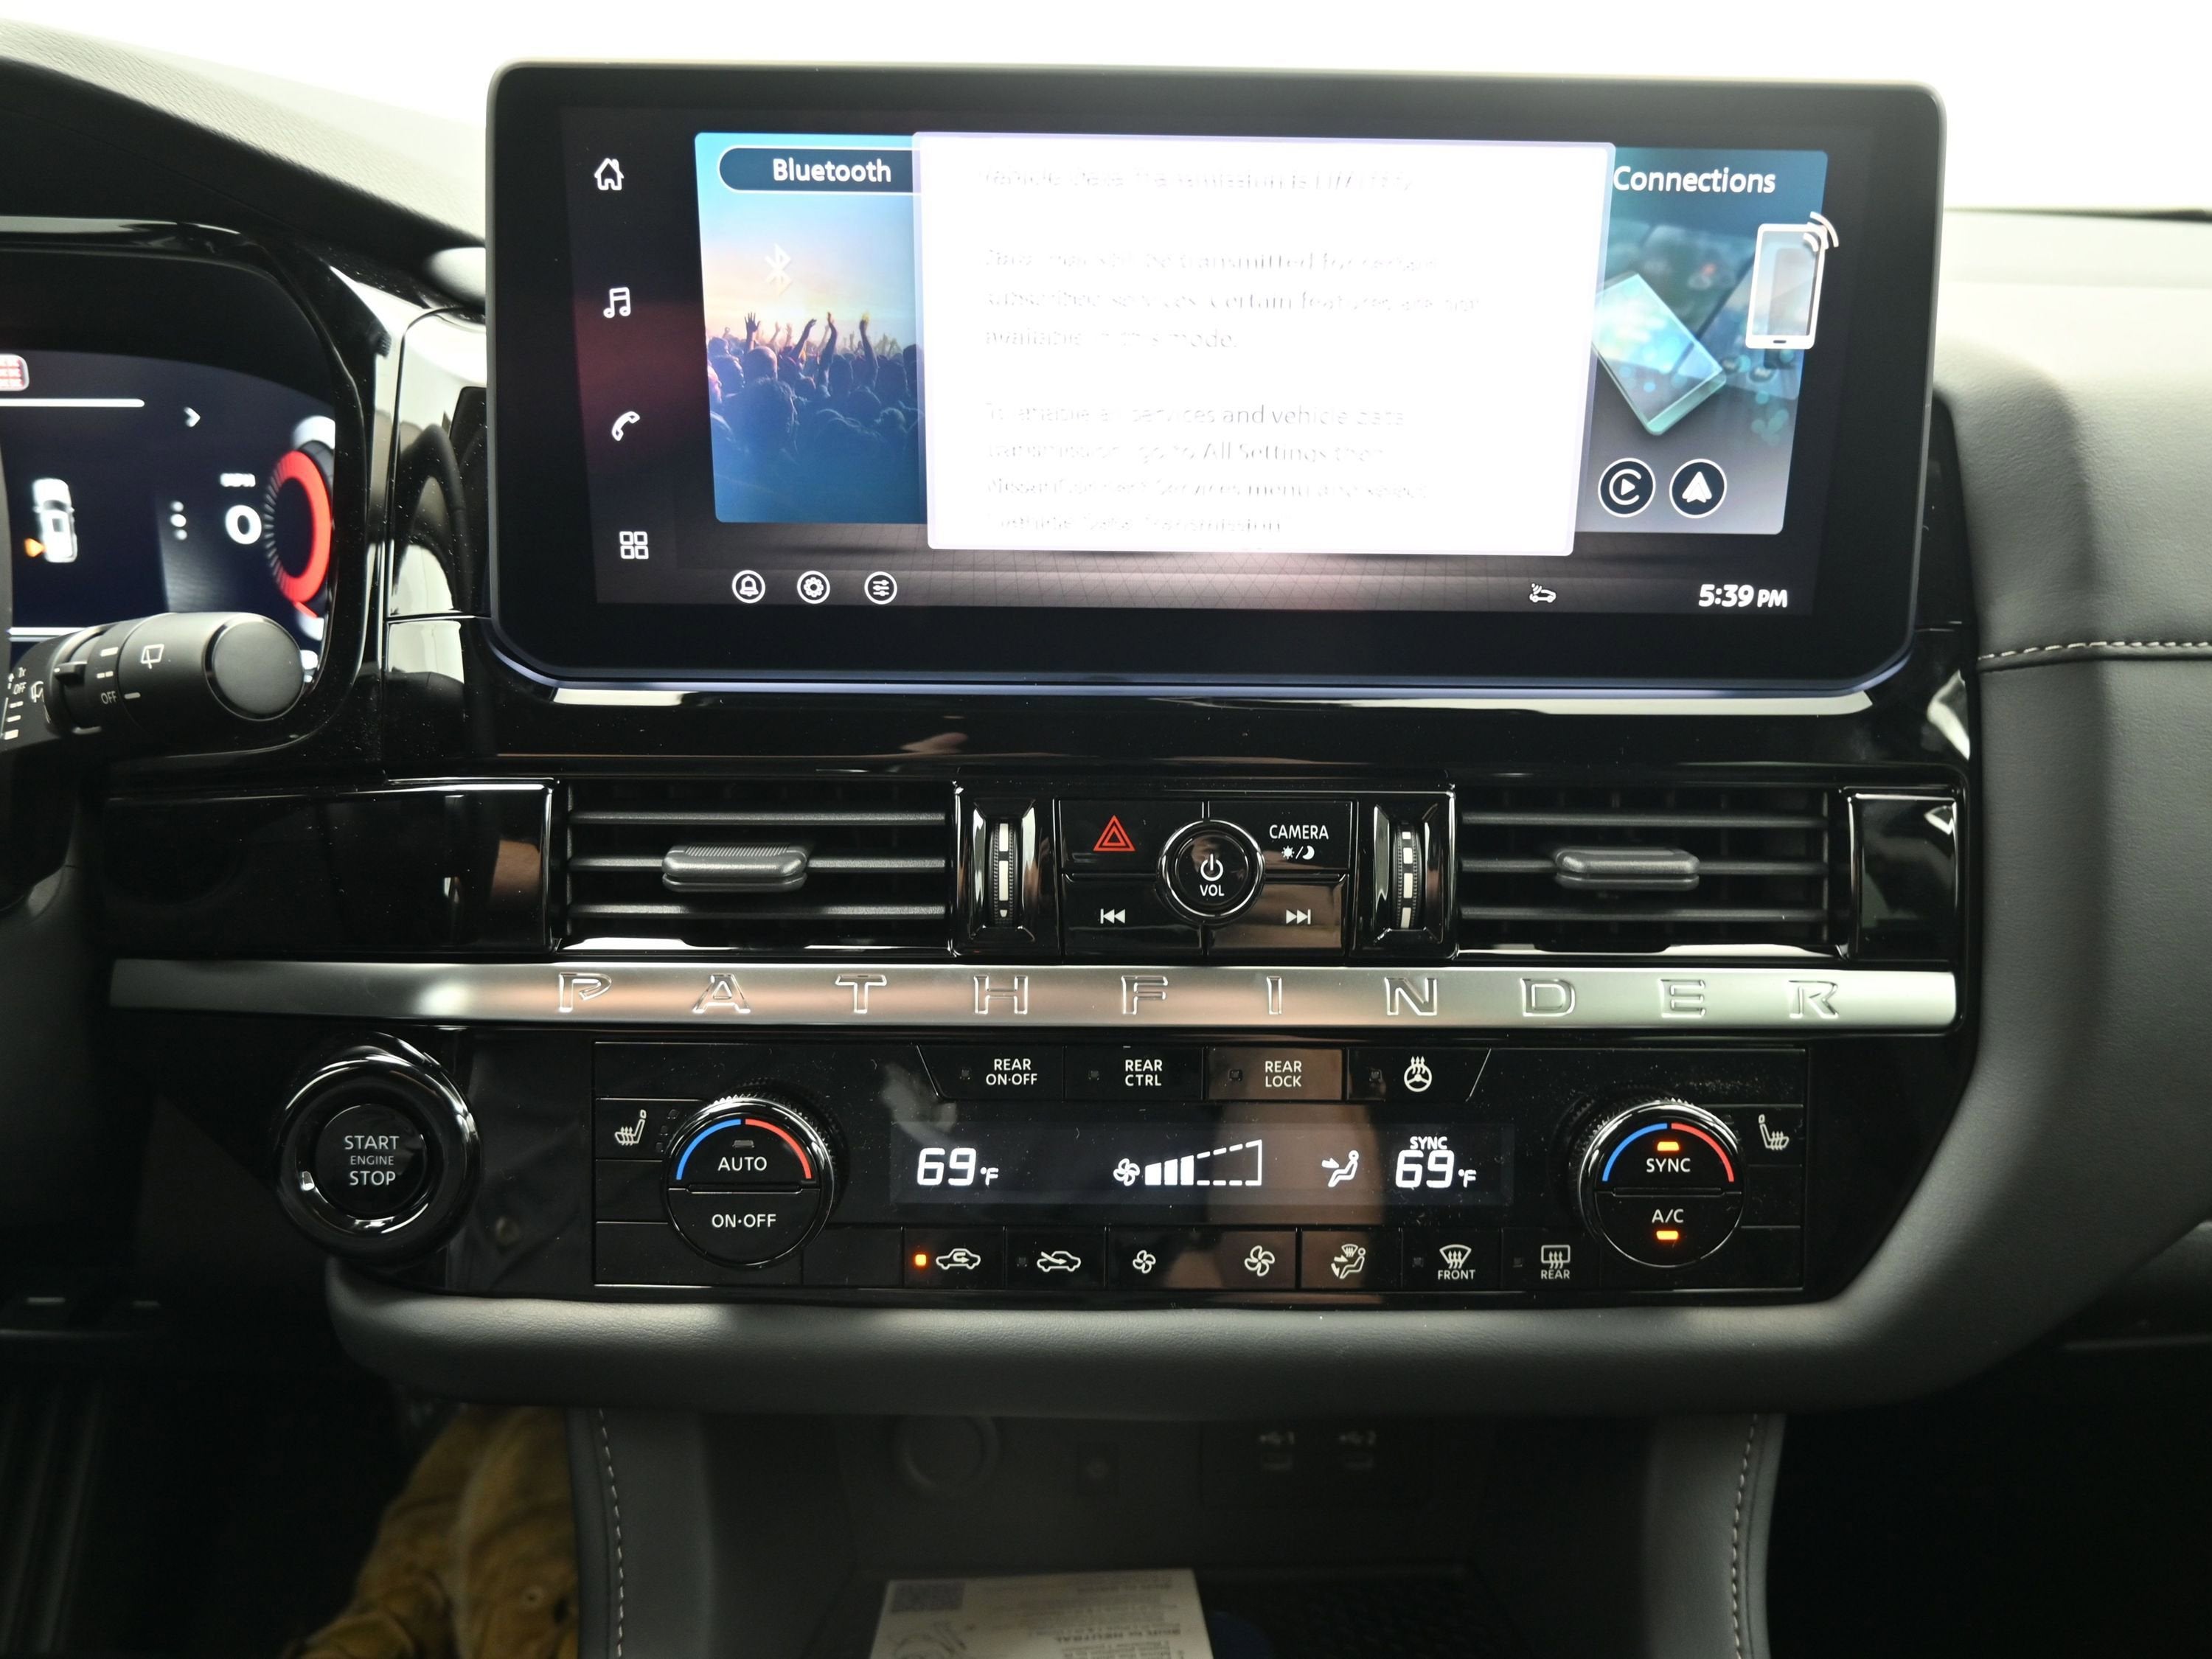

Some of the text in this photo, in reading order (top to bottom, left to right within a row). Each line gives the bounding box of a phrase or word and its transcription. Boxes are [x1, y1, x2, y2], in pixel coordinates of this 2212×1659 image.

[773, 157, 891, 183] Bluetooth
[1613, 166, 1776, 194] Connections
[1222, 403, 1265, 425] and
[1271, 402, 1349, 426] vehicle
[1203, 440, 1232, 461] All
[1698, 584, 1788, 608] 5:39 PM
[13, 681, 27, 695] OFF
[100, 691, 117, 705] OFF
[1269, 824, 1329, 840] CAMERA
[1199, 884, 1225, 897] VOL
[557, 971, 1840, 1020] PATHFINDER
[994, 1058, 1032, 1071] REAR
[1125, 1059, 1163, 1072] REAR
[1265, 1060, 1302, 1073] REAR
[1124, 1074, 1162, 1087] CTRL
[1265, 1075, 1302, 1088] LOCK
[344, 1135, 400, 1150] START
[1409, 1135, 1448, 1150] SYNC
[350, 1155, 394, 1166] ENGINE
[717, 1156, 768, 1172] AUTO
[1646, 1158, 1691, 1173] SYNC
[349, 1170, 396, 1186] STOP
[1651, 1208, 1684, 1224] A/C
[1437, 1270, 1475, 1280] FRONT
[1540, 1270, 1571, 1280] REAR
